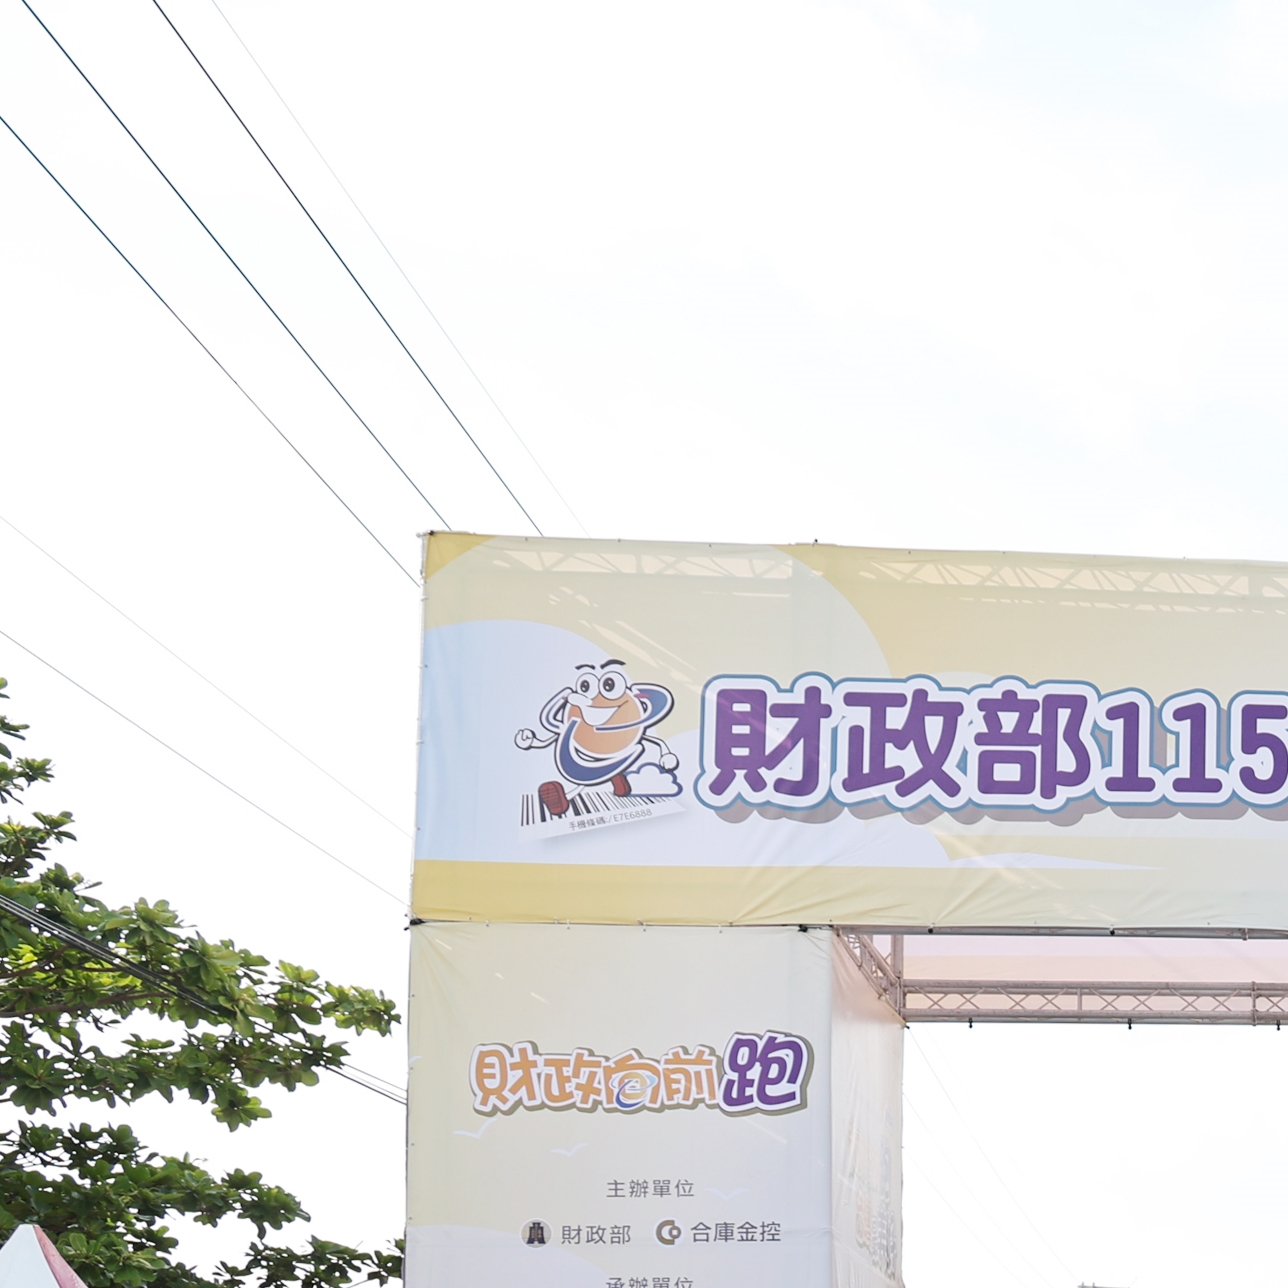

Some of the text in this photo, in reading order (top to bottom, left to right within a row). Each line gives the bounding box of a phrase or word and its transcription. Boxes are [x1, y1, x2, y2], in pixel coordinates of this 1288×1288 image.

[474, 1033, 804, 1108] 財政向前跑
[606, 1178, 695, 1199] 主辦單位
[561, 1224, 632, 1245] 財政部
[690, 1221, 782, 1243] 合庫金控
